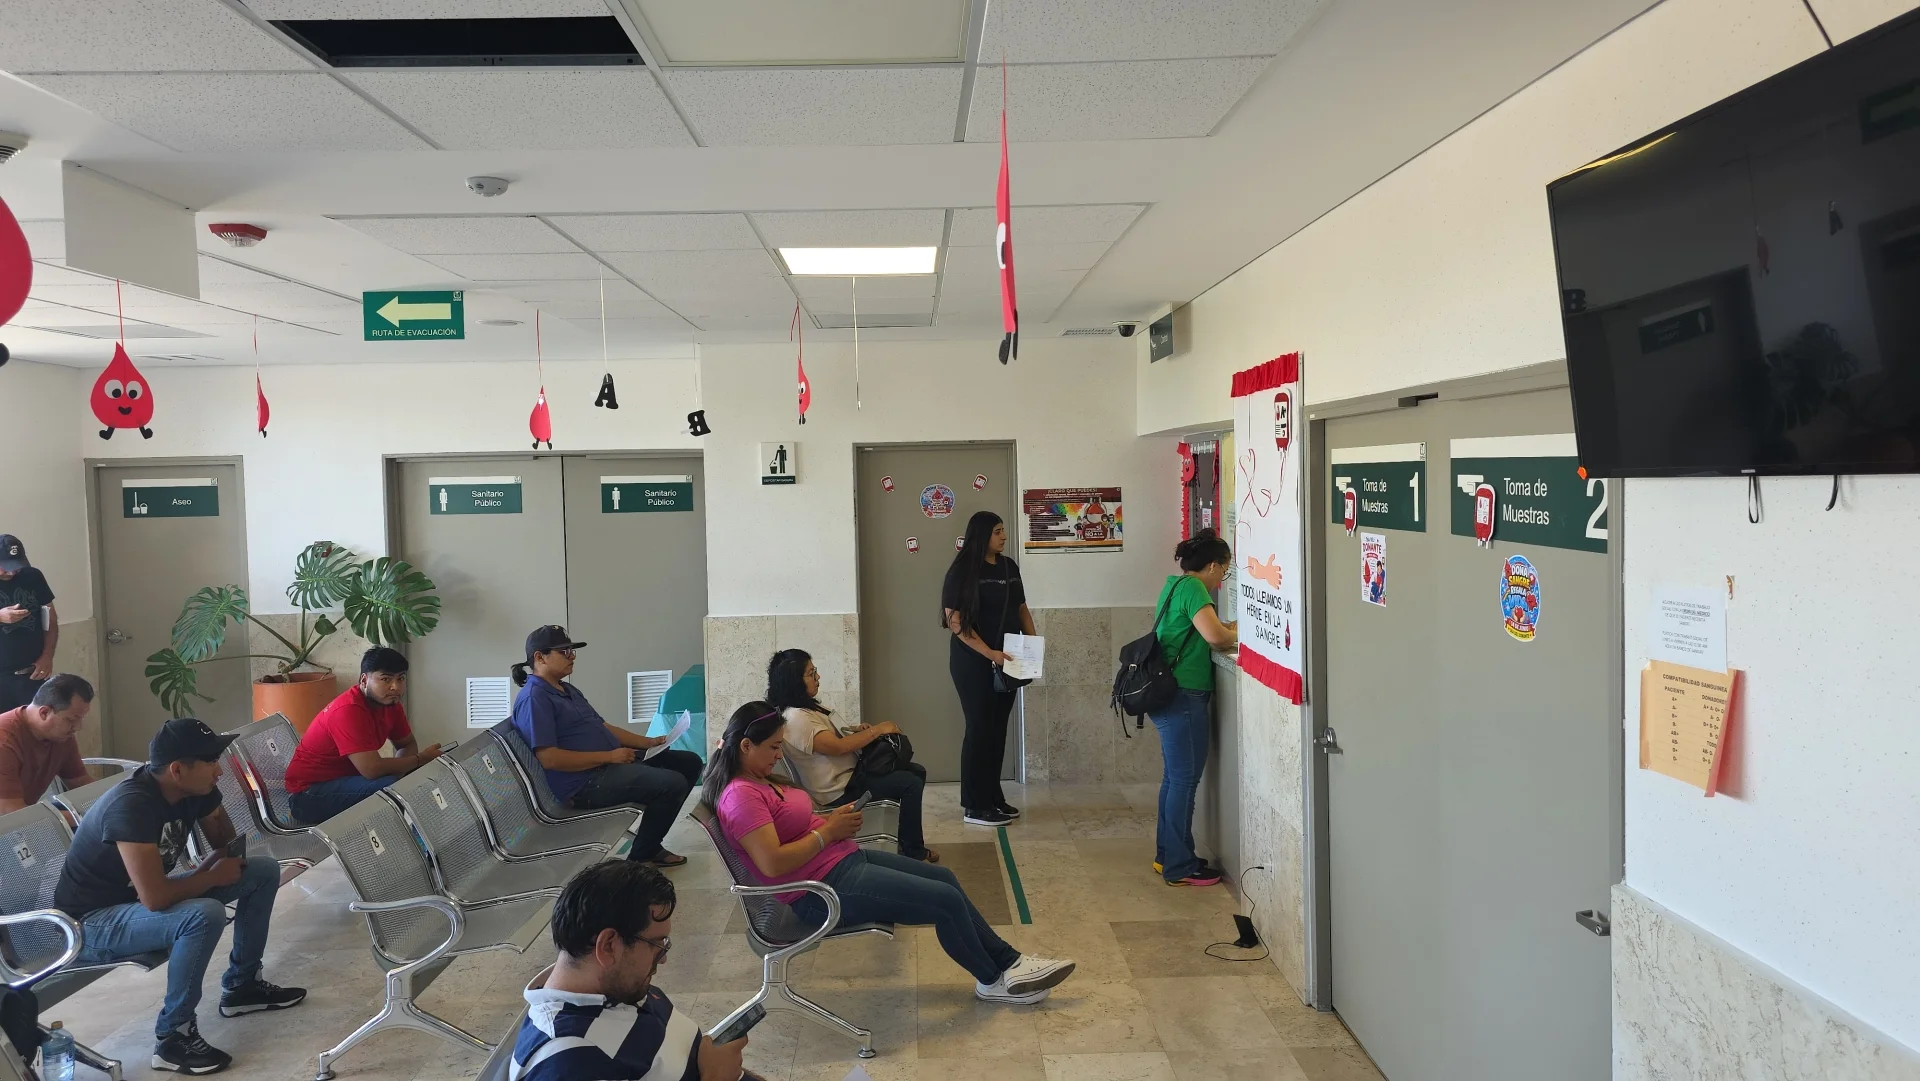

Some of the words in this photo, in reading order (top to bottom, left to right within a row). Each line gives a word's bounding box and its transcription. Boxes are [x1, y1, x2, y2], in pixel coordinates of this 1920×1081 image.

[407, 328, 456, 336] EVACUACIÓN
[594, 373, 618, 410] A
[1362, 478, 1378, 492] Toma
[1379, 478, 1387, 492] de
[1504, 477, 1531, 496] Toma
[1534, 478, 1547, 497] de
[1409, 472, 1419, 521] 1
[1362, 498, 1388, 513] Muestras
[1586, 478, 1608, 540] 2
[1503, 504, 1550, 525] Muestras
[1363, 543, 1381, 554] DONANTE
[1511, 565, 1528, 577] DONA
[1508, 575, 1530, 588] SANGRE
[1256, 590, 1282, 610] LLEVAMOS
[1284, 600, 1292, 614] UN
[1265, 610, 1271, 625] EN
[1273, 614, 1281, 628] LA
[1255, 625, 1281, 649] SANGRE
[1663, 674, 1700, 686] COMPATIBILIDAD
[1665, 686, 1685, 695] PACIENTE
[270, 742, 276, 752] 9
[437, 793, 443, 804] 7
[371, 836, 380, 848] 8
[17, 847, 31, 860] 12
